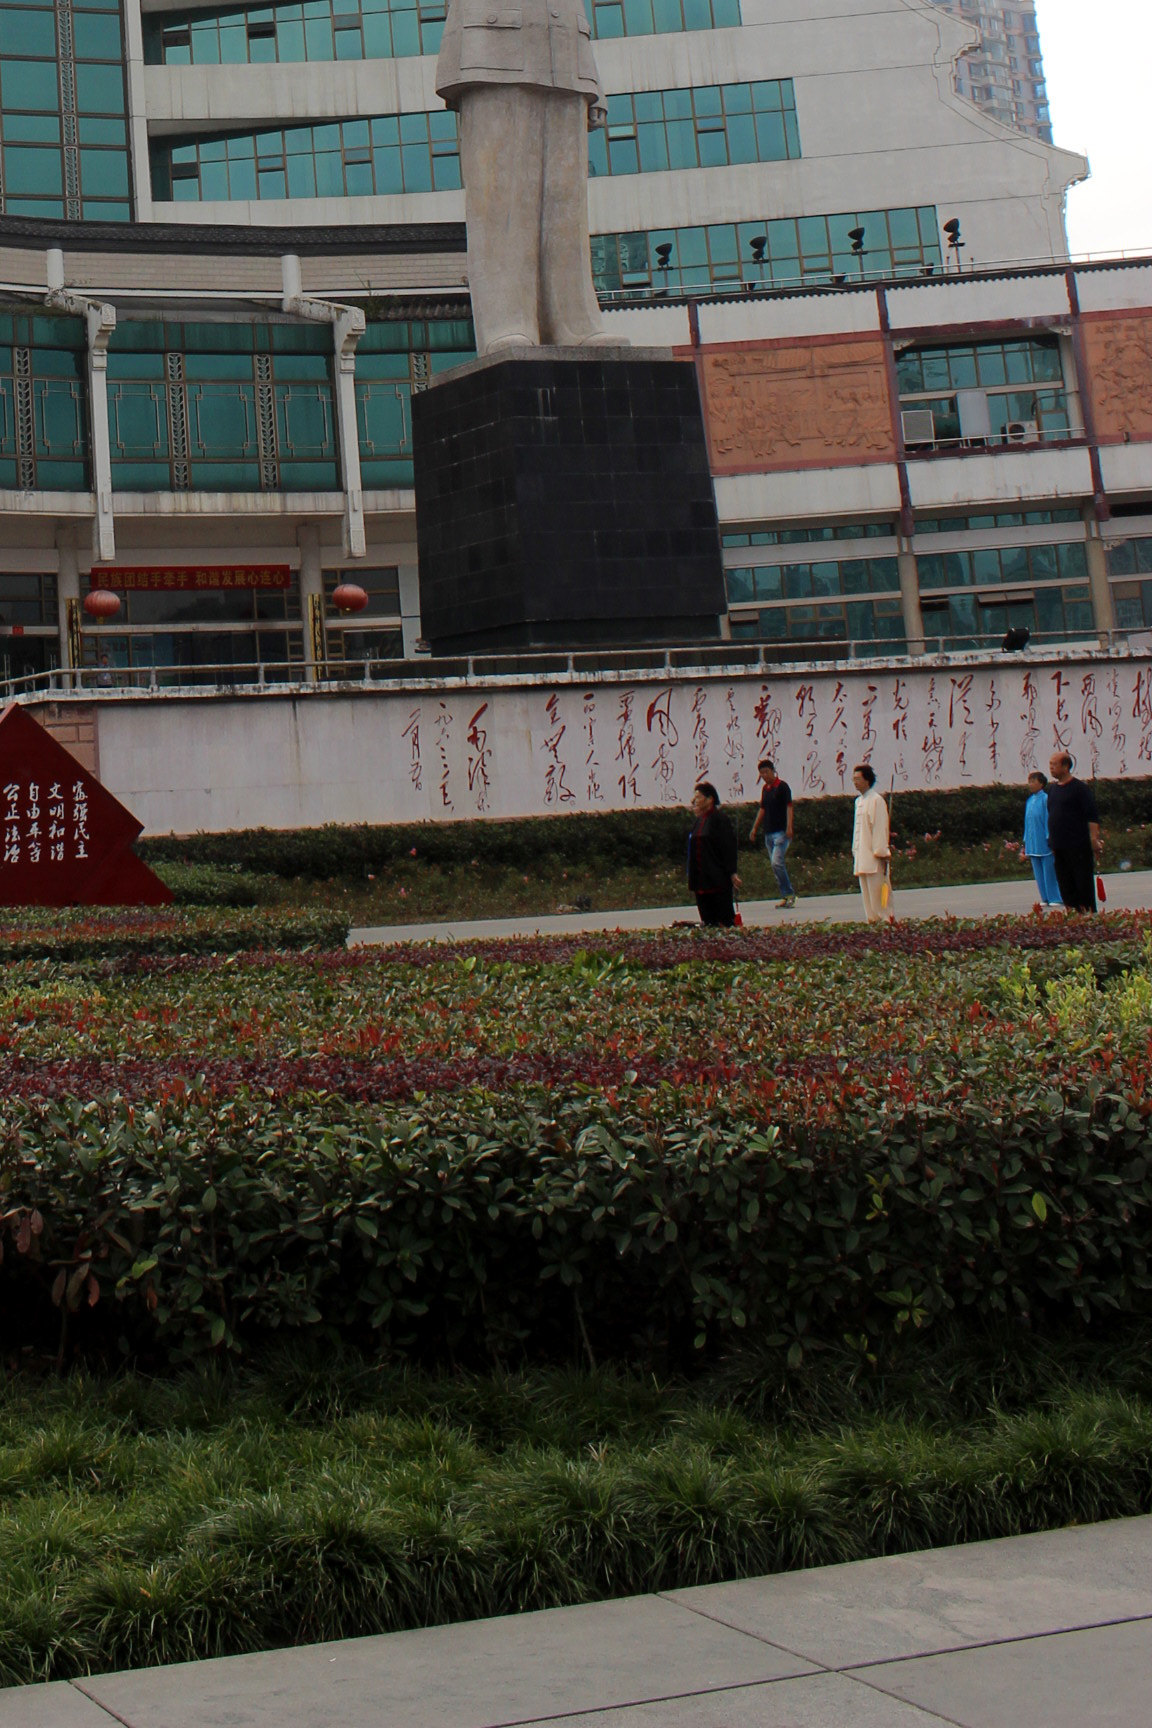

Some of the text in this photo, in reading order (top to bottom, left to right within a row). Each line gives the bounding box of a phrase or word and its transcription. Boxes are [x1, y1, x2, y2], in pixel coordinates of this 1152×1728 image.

[97, 570, 286, 588] 民族团结手牵手 和谐发展心连心
[3, 783, 21, 863] 公正法治
[26, 782, 42, 863] 自由平等
[47, 782, 65, 861] 文明和谐
[72, 780, 90, 859] 富强民主
